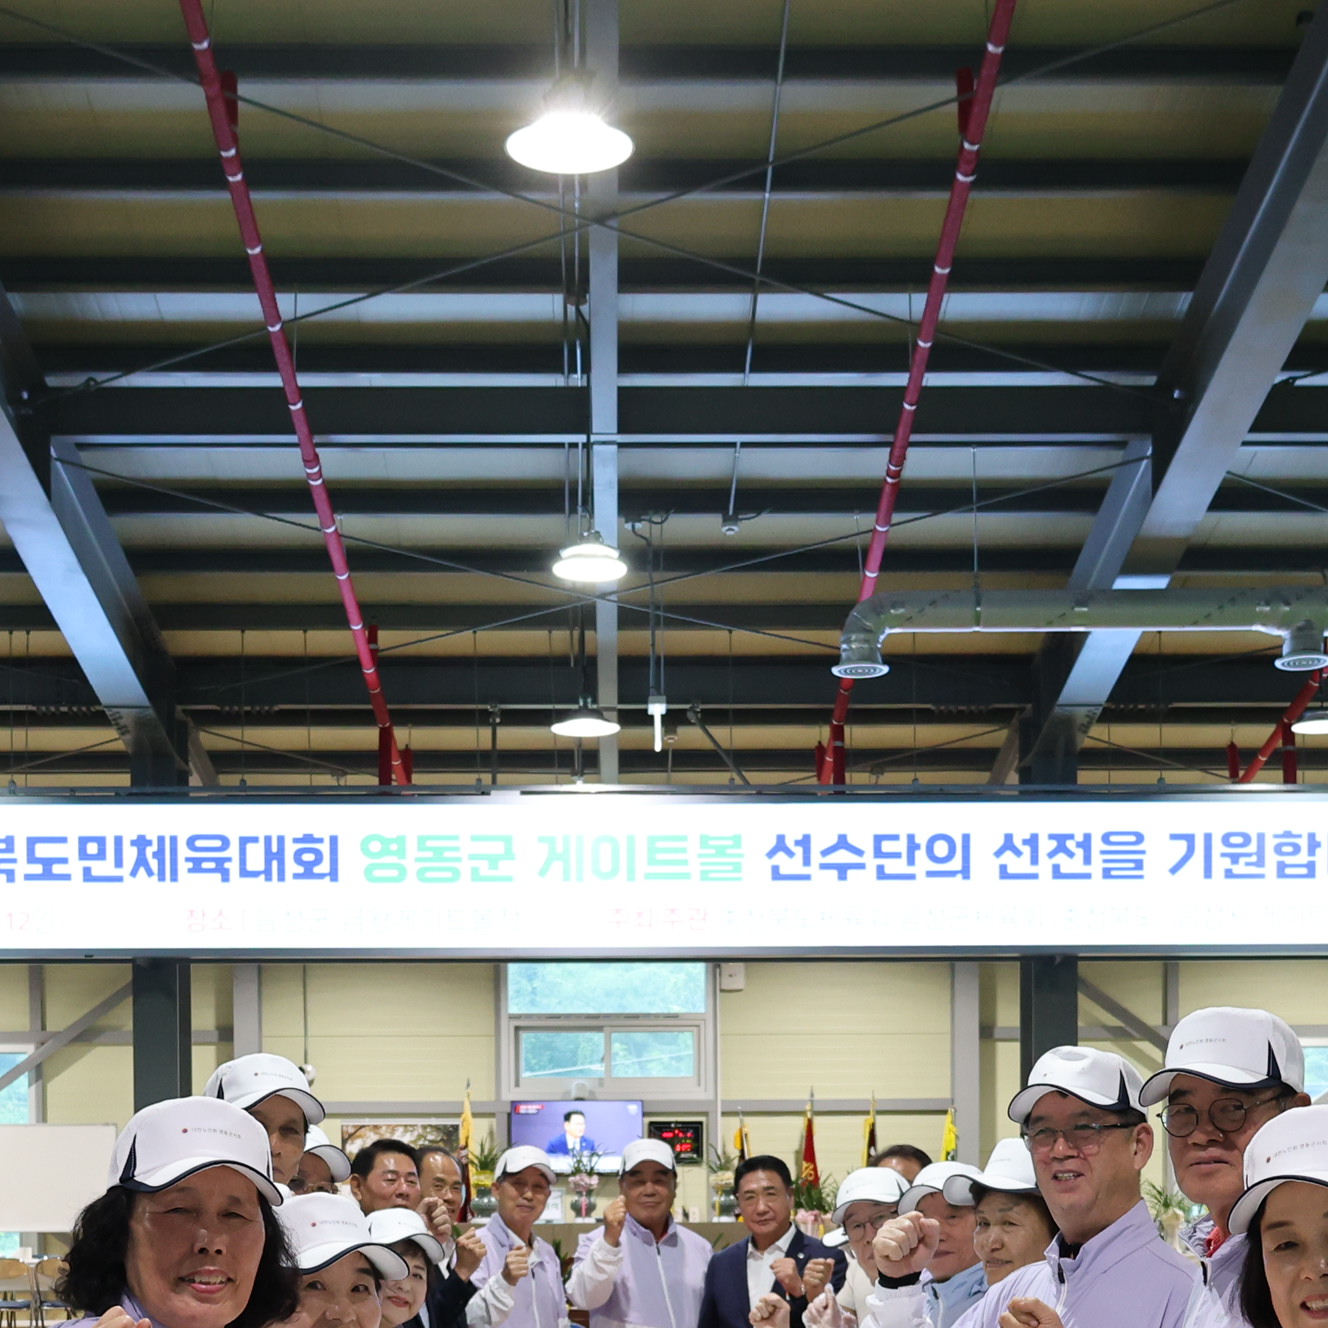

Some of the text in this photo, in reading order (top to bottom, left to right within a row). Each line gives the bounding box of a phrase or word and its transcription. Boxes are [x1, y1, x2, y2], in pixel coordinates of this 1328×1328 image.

[360, 833, 516, 883] 영동군
[538, 833, 745, 881] 게이트볼
[764, 832, 972, 881] 선수단의
[992, 830, 1147, 880] 선전을
